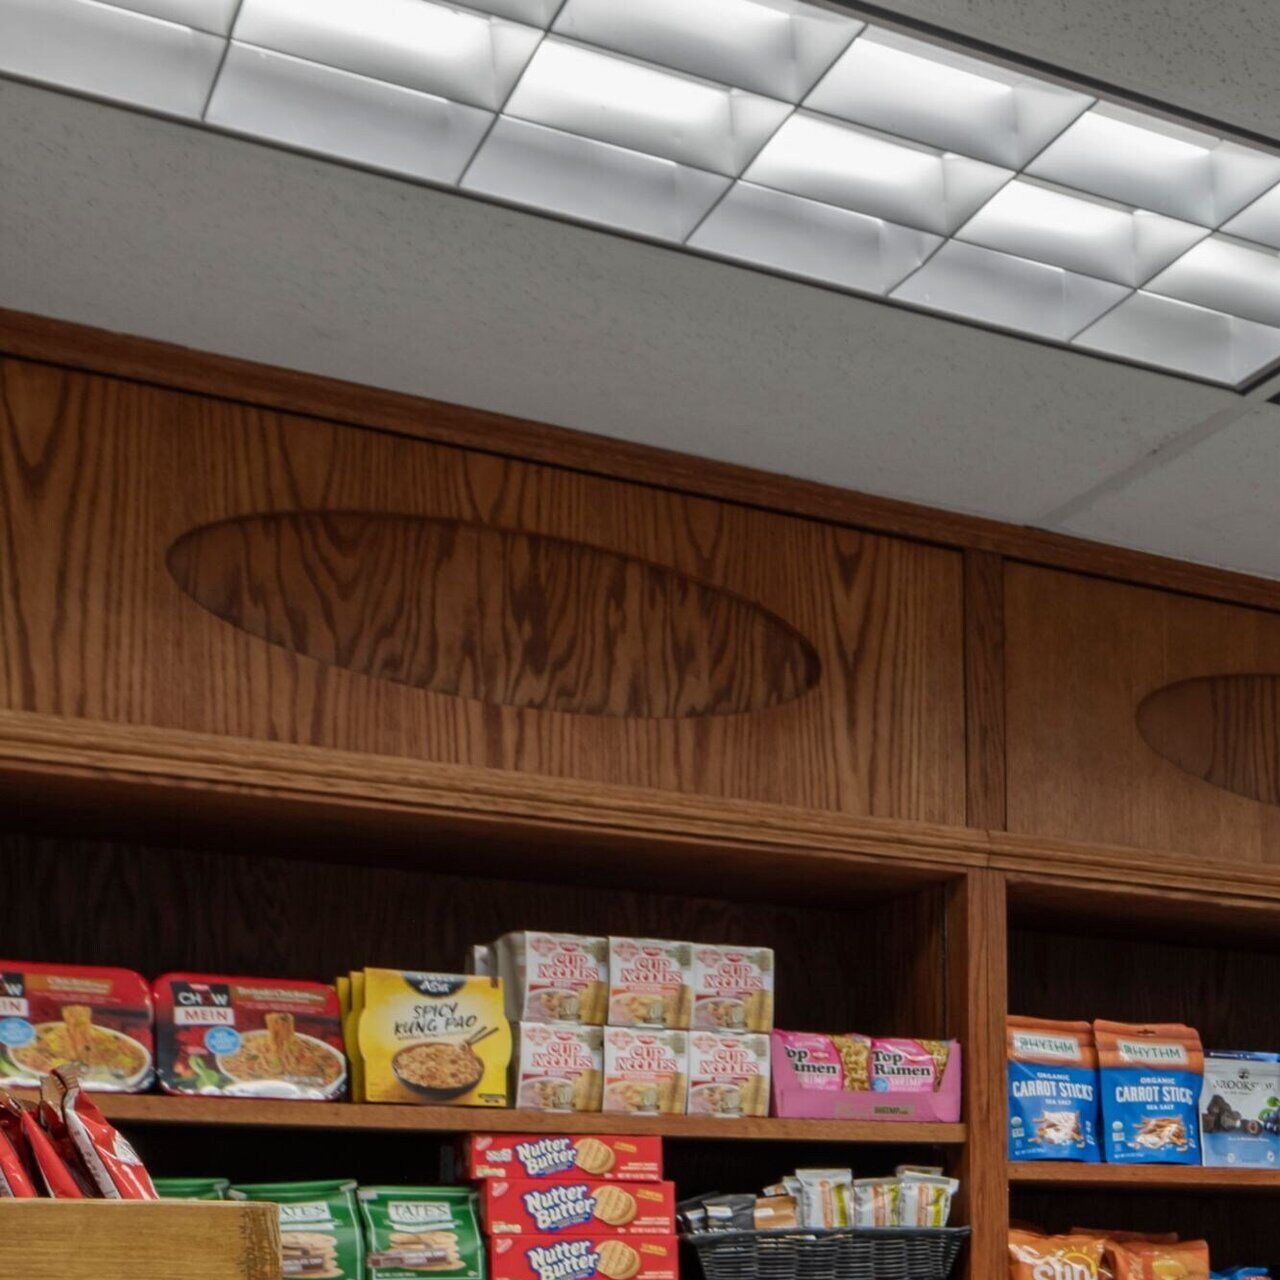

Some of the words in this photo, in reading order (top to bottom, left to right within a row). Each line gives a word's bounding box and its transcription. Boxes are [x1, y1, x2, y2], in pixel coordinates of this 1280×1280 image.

[538, 964, 599, 980] NOODLES
[185, 1010, 228, 1022] MEIN
[413, 1002, 458, 1019] SPICY
[394, 1020, 438, 1036] KUNG
[873, 1051, 903, 1064] Top
[874, 1063, 931, 1076] Ramen
[1012, 1080, 1058, 1098] CARROT
[1059, 1082, 1093, 1101] STICKS
[1116, 1086, 1160, 1103] CARROT
[516, 1137, 571, 1159] Nutter
[525, 1150, 577, 1174] Butter
[524, 1185, 588, 1213] Nutter
[534, 1200, 596, 1228] Butter
[527, 1240, 590, 1269] Nutter
